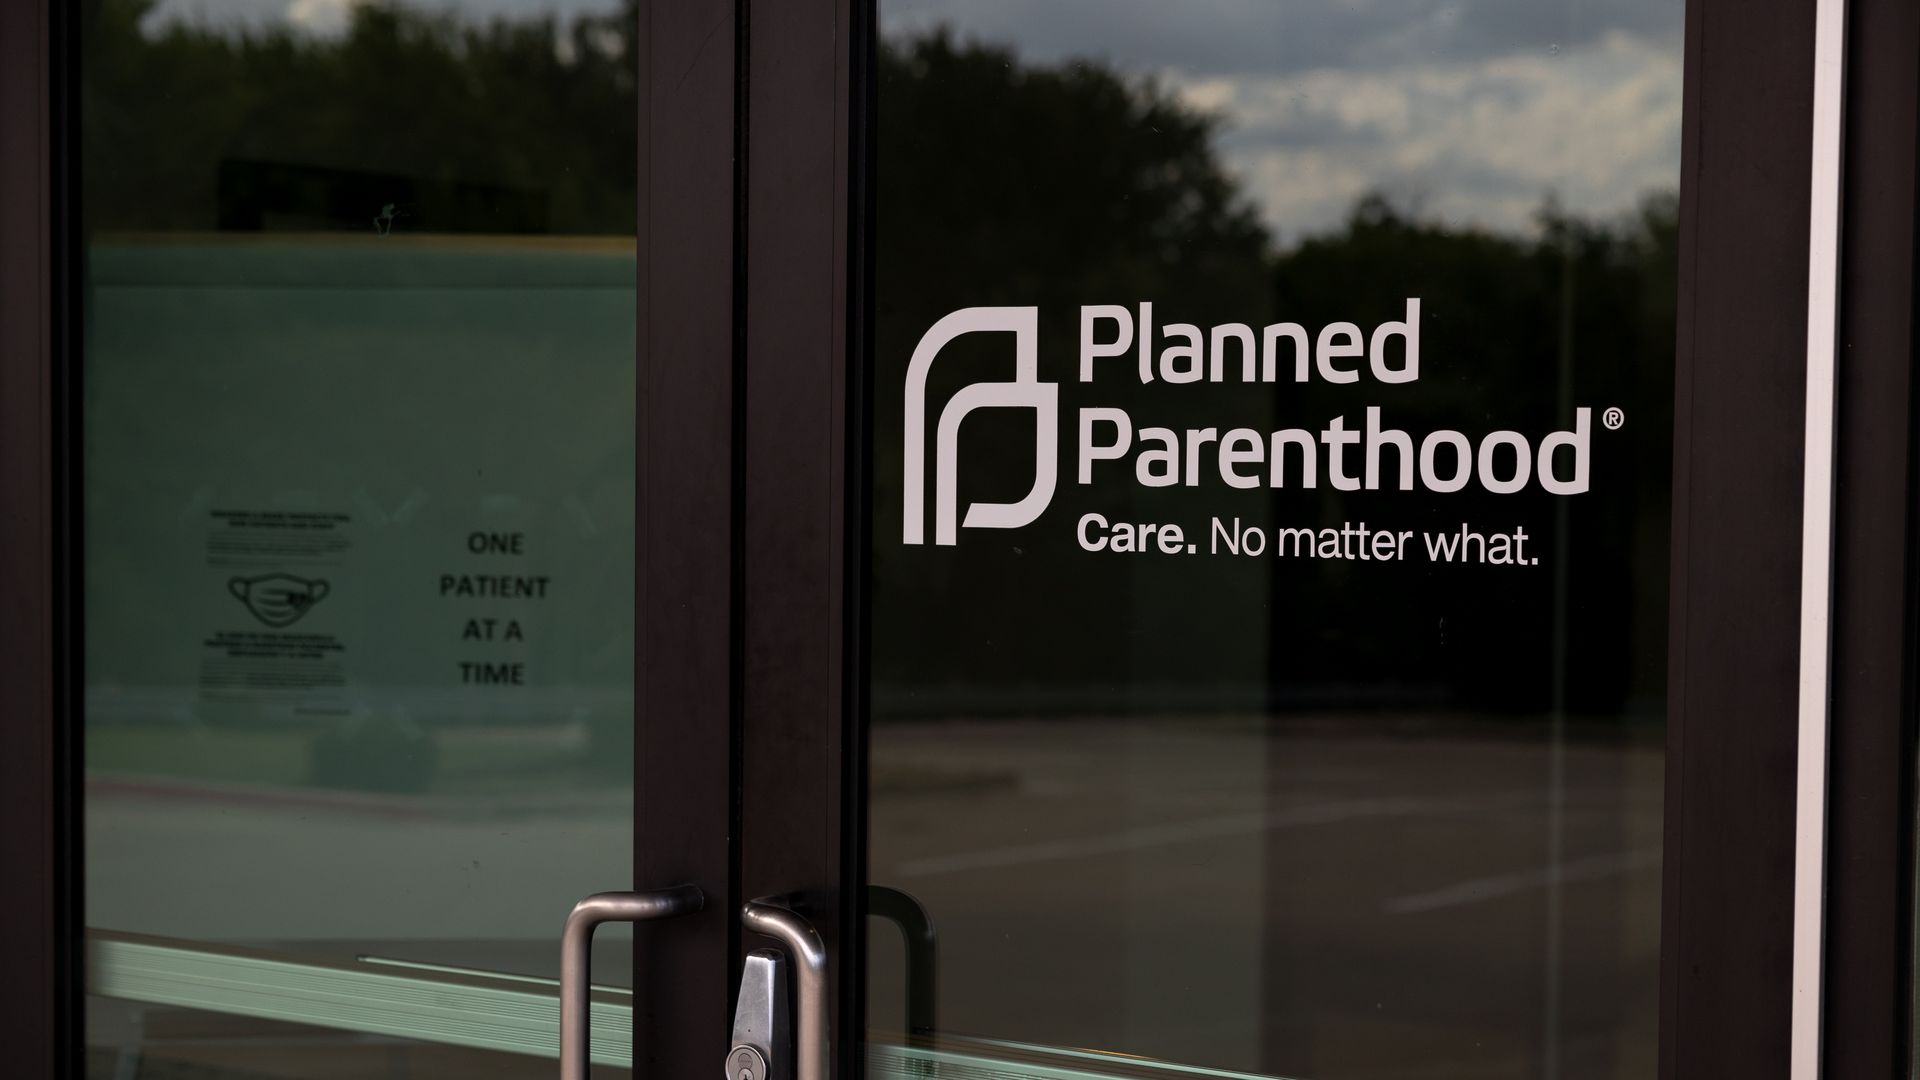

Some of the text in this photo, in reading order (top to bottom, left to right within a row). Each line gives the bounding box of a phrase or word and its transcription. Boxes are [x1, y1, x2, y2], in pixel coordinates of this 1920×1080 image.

[1079, 297, 1421, 386] Planned
[467, 531, 524, 555] ONE
[1077, 512, 1540, 566] Care. No matter what.
[439, 574, 550, 599] PATIENT
[462, 618, 524, 642] AT A
[458, 661, 525, 686] TIME
